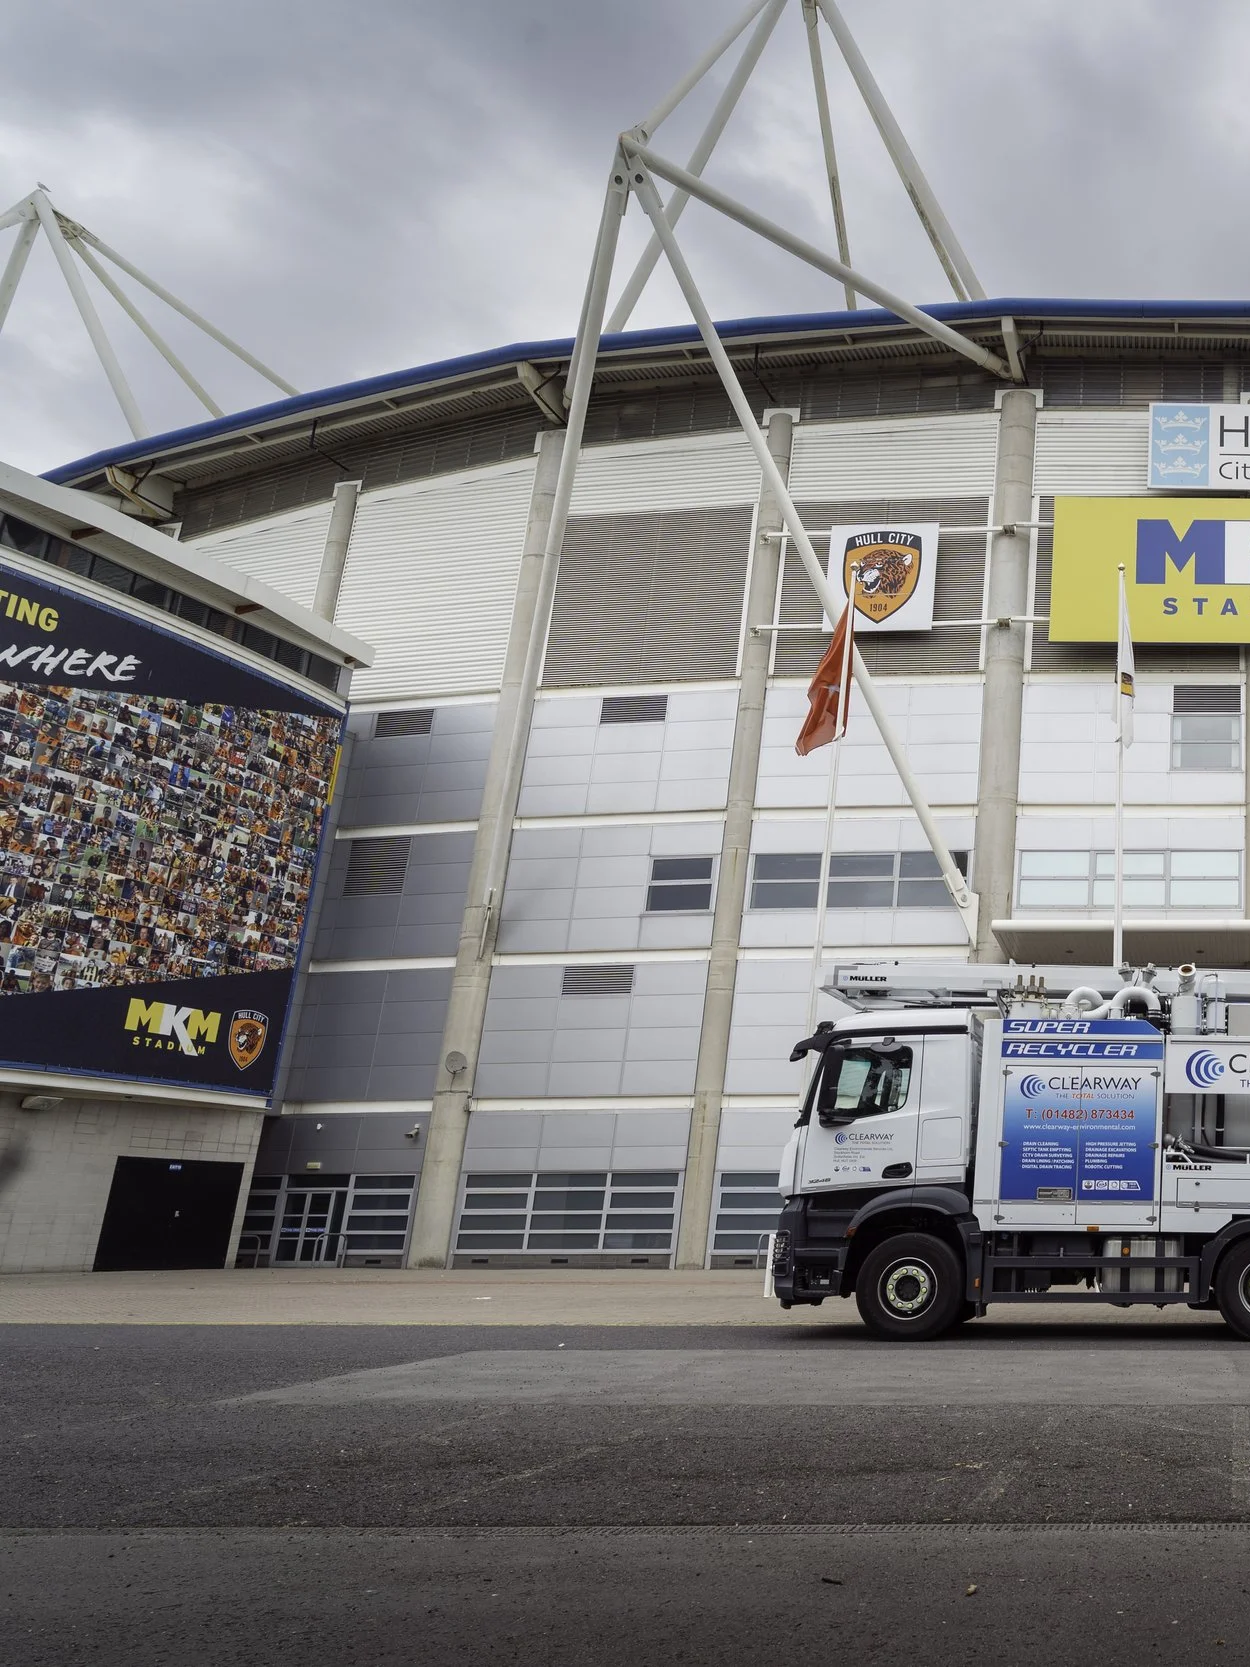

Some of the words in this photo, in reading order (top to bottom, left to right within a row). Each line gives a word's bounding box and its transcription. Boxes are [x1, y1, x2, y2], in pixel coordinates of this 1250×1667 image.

[855, 532, 883, 547] HULL
[888, 532, 914, 546] CITY
[869, 603, 888, 612] 1904
[238, 1011, 251, 1020] HULL
[252, 1013, 265, 1023] CITY
[124, 998, 222, 1057] MKM
[1007, 1021, 1091, 1033] SUPER
[132, 1036, 206, 1055] STADIUM
[1006, 1043, 1139, 1056] RECYCLER
[1048, 1076, 1141, 1090] CLEARWAY
[1025, 1108, 1037, 1119] T:
[1041, 1109, 1088, 1120] (01482)
[1091, 1109, 1135, 1120] 873434
[848, 1133, 894, 1141] CLEARWAY
